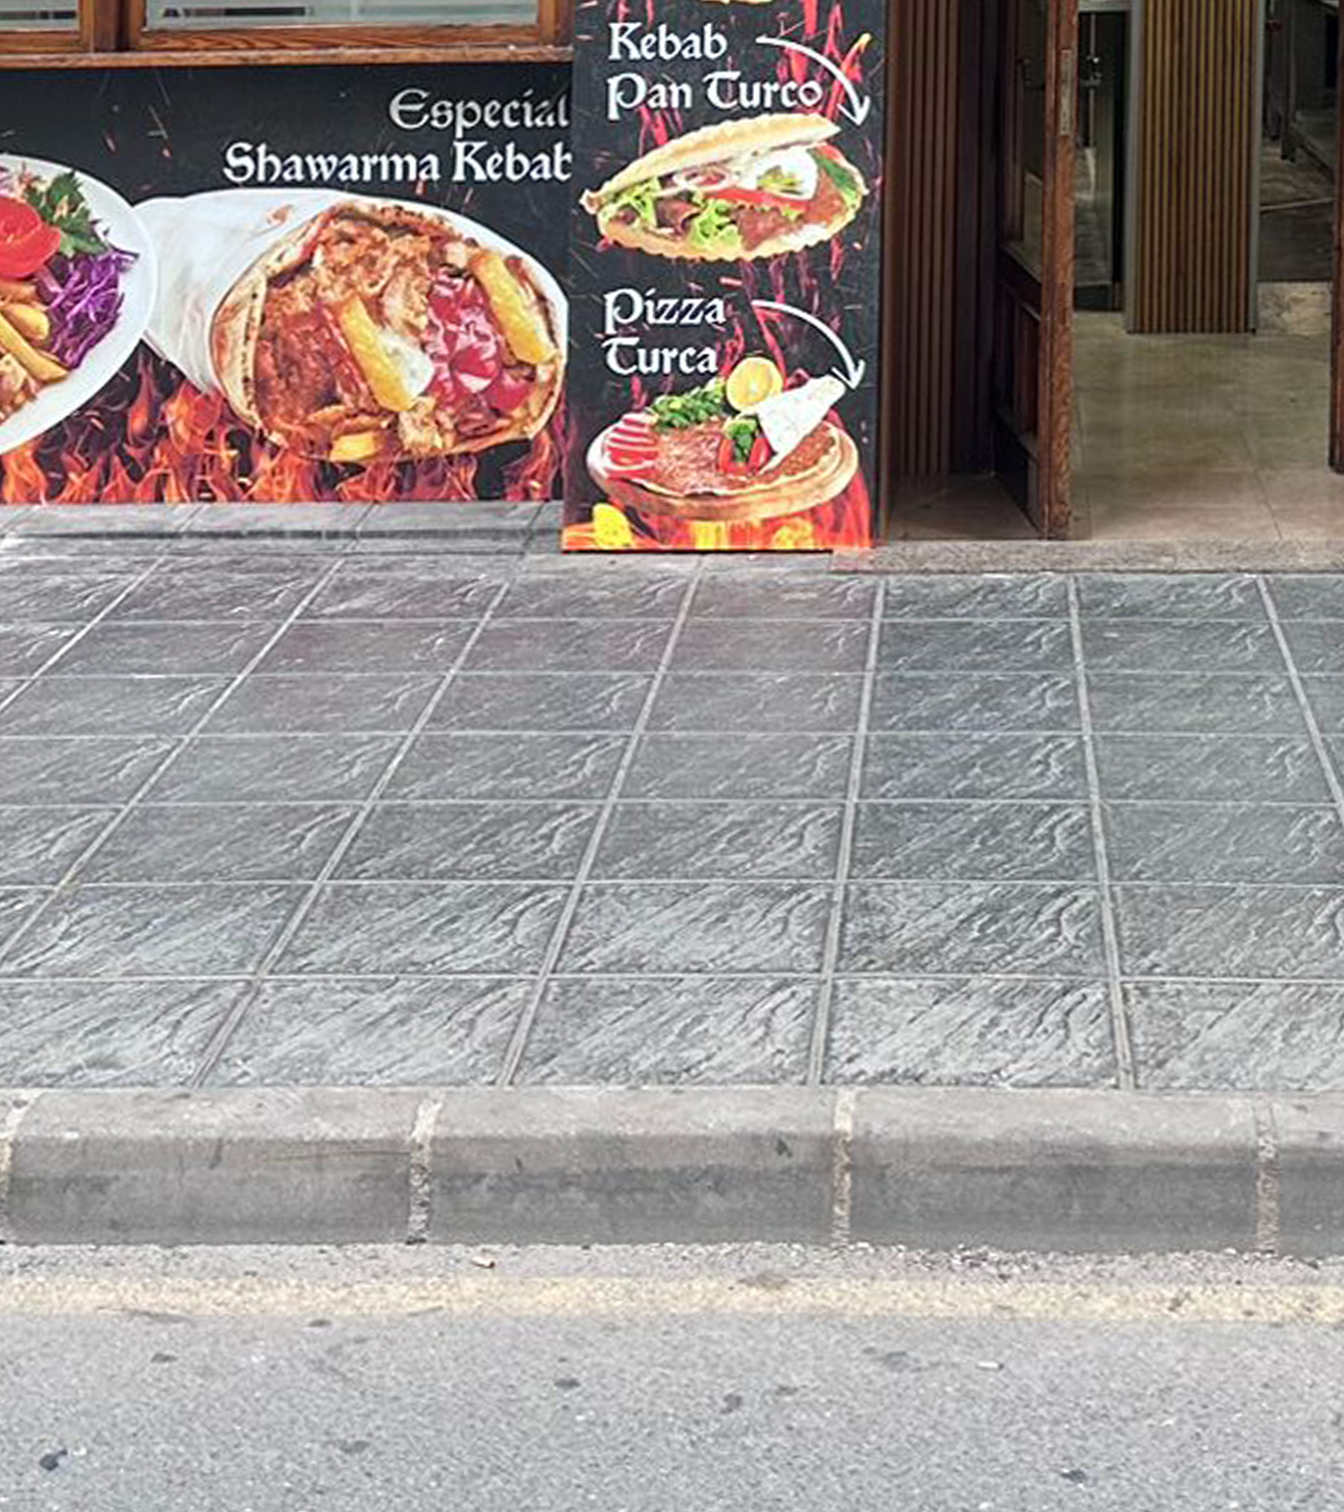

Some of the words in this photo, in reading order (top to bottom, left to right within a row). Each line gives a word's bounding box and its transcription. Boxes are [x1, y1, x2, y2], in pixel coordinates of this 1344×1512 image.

[608, 22, 728, 61] Kebab
[389, 88, 570, 139] Especial
[606, 72, 692, 121] Pan
[702, 70, 824, 109] Turco
[222, 141, 441, 183] Shawarma
[451, 140, 573, 182] Kebab
[604, 287, 727, 335] Pizza
[602, 336, 719, 375] Turca
